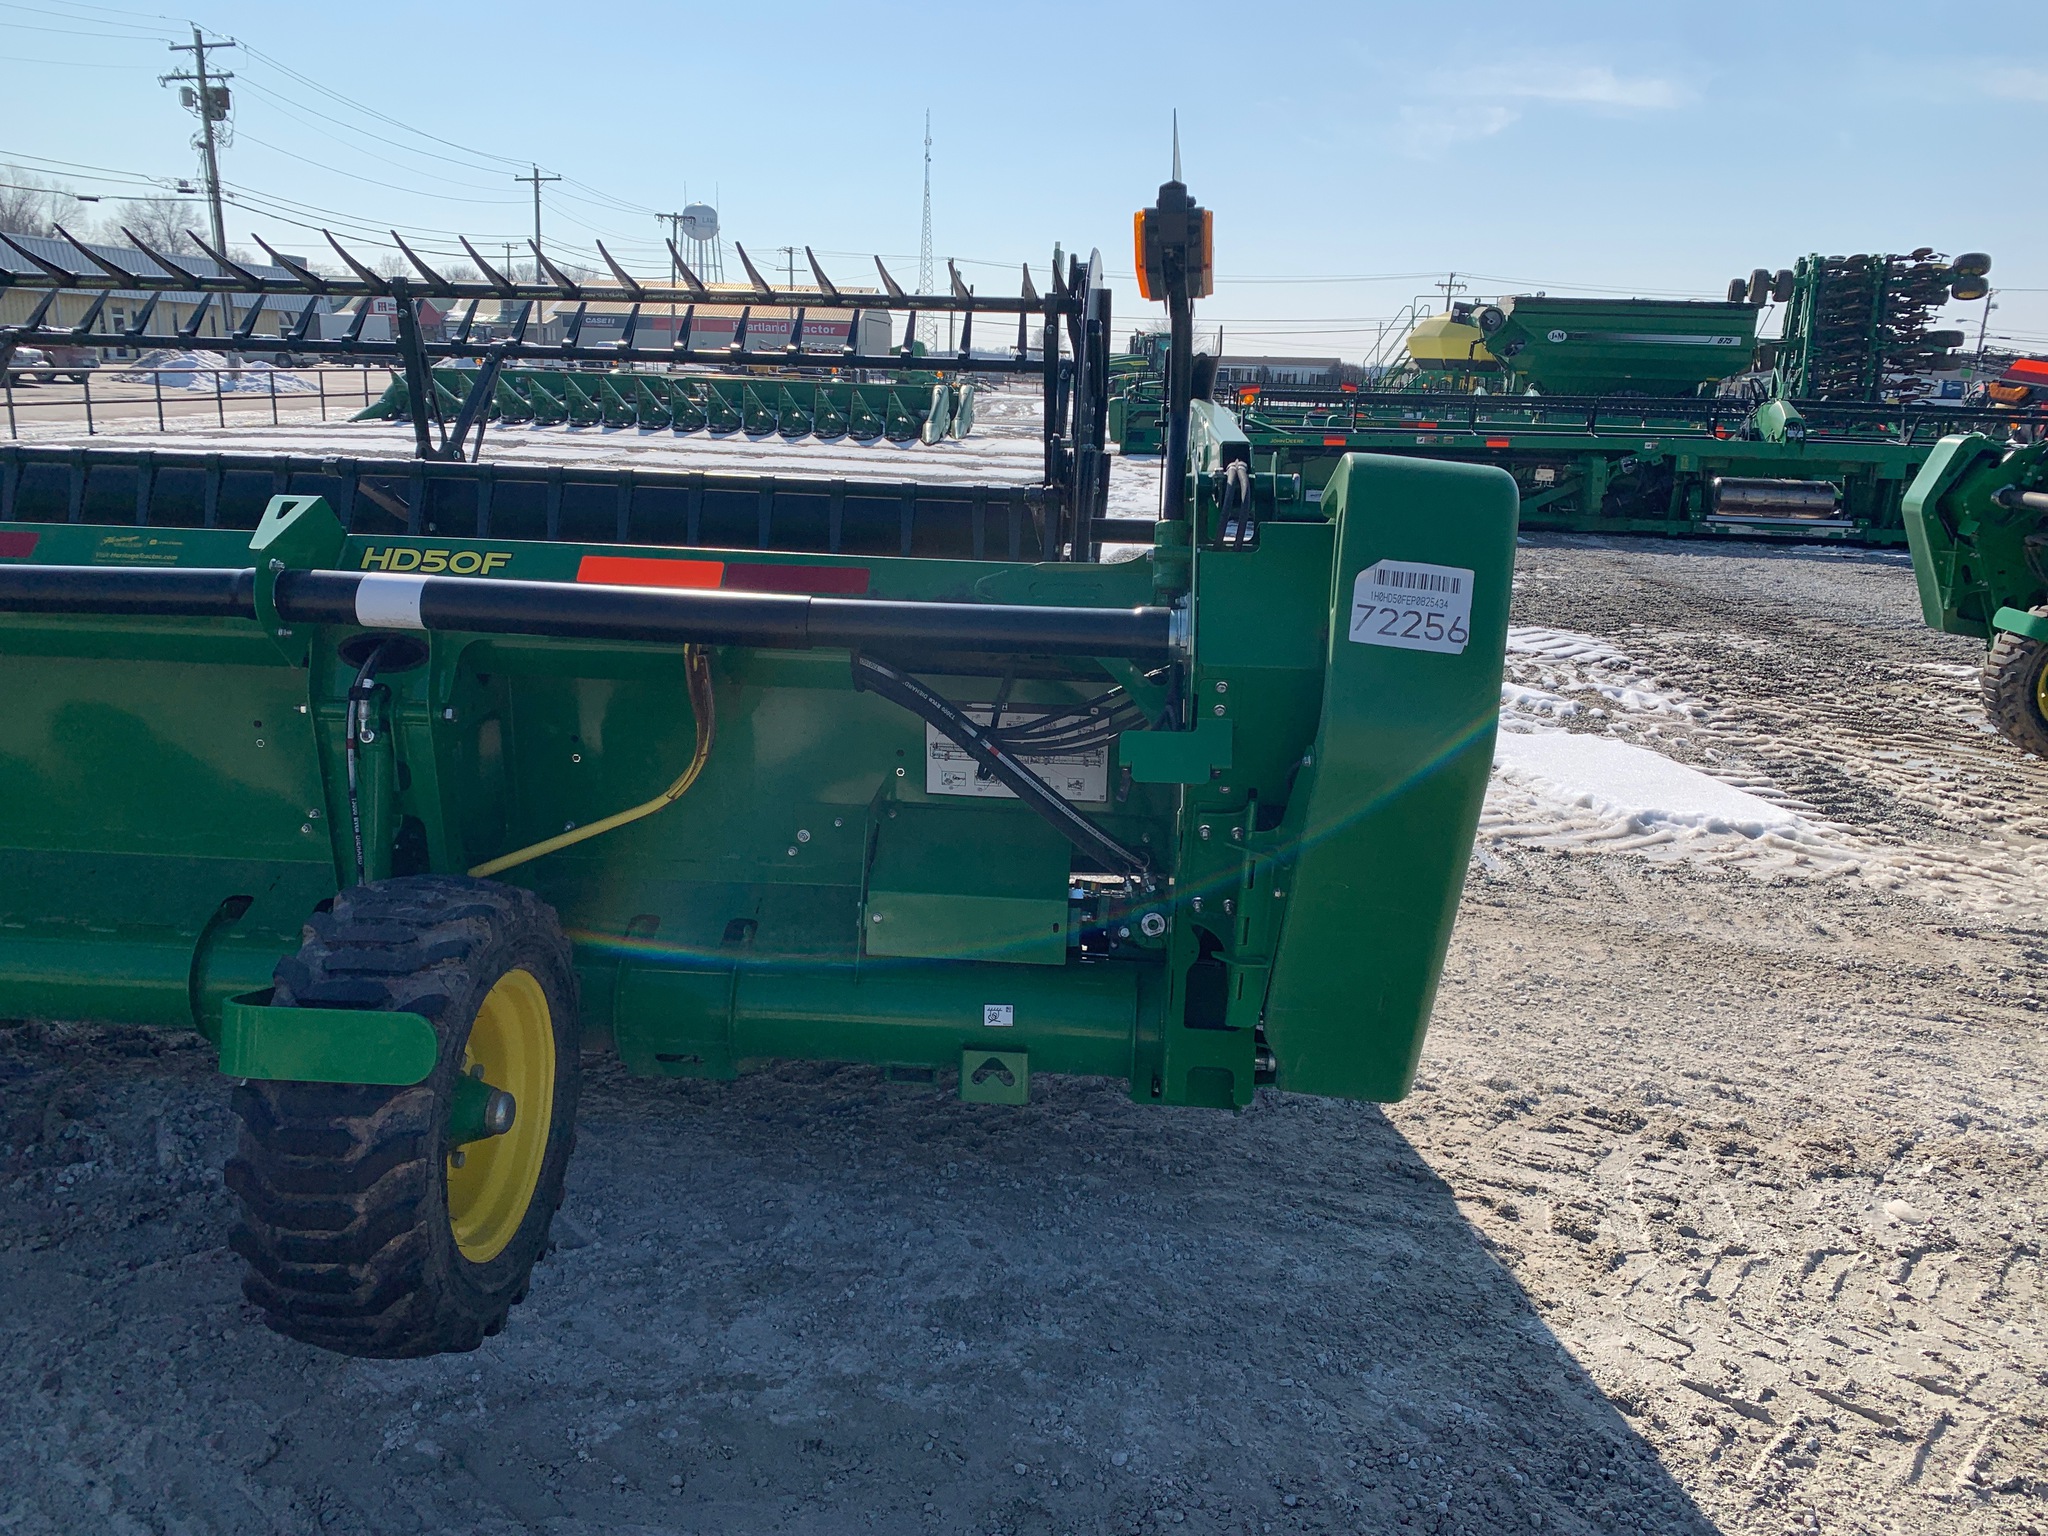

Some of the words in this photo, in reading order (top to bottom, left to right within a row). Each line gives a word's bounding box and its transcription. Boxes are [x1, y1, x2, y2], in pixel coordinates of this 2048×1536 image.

[732, 321, 787, 333] Hartland
[359, 546, 513, 576] HD50F
[1354, 603, 1468, 644] 72256
